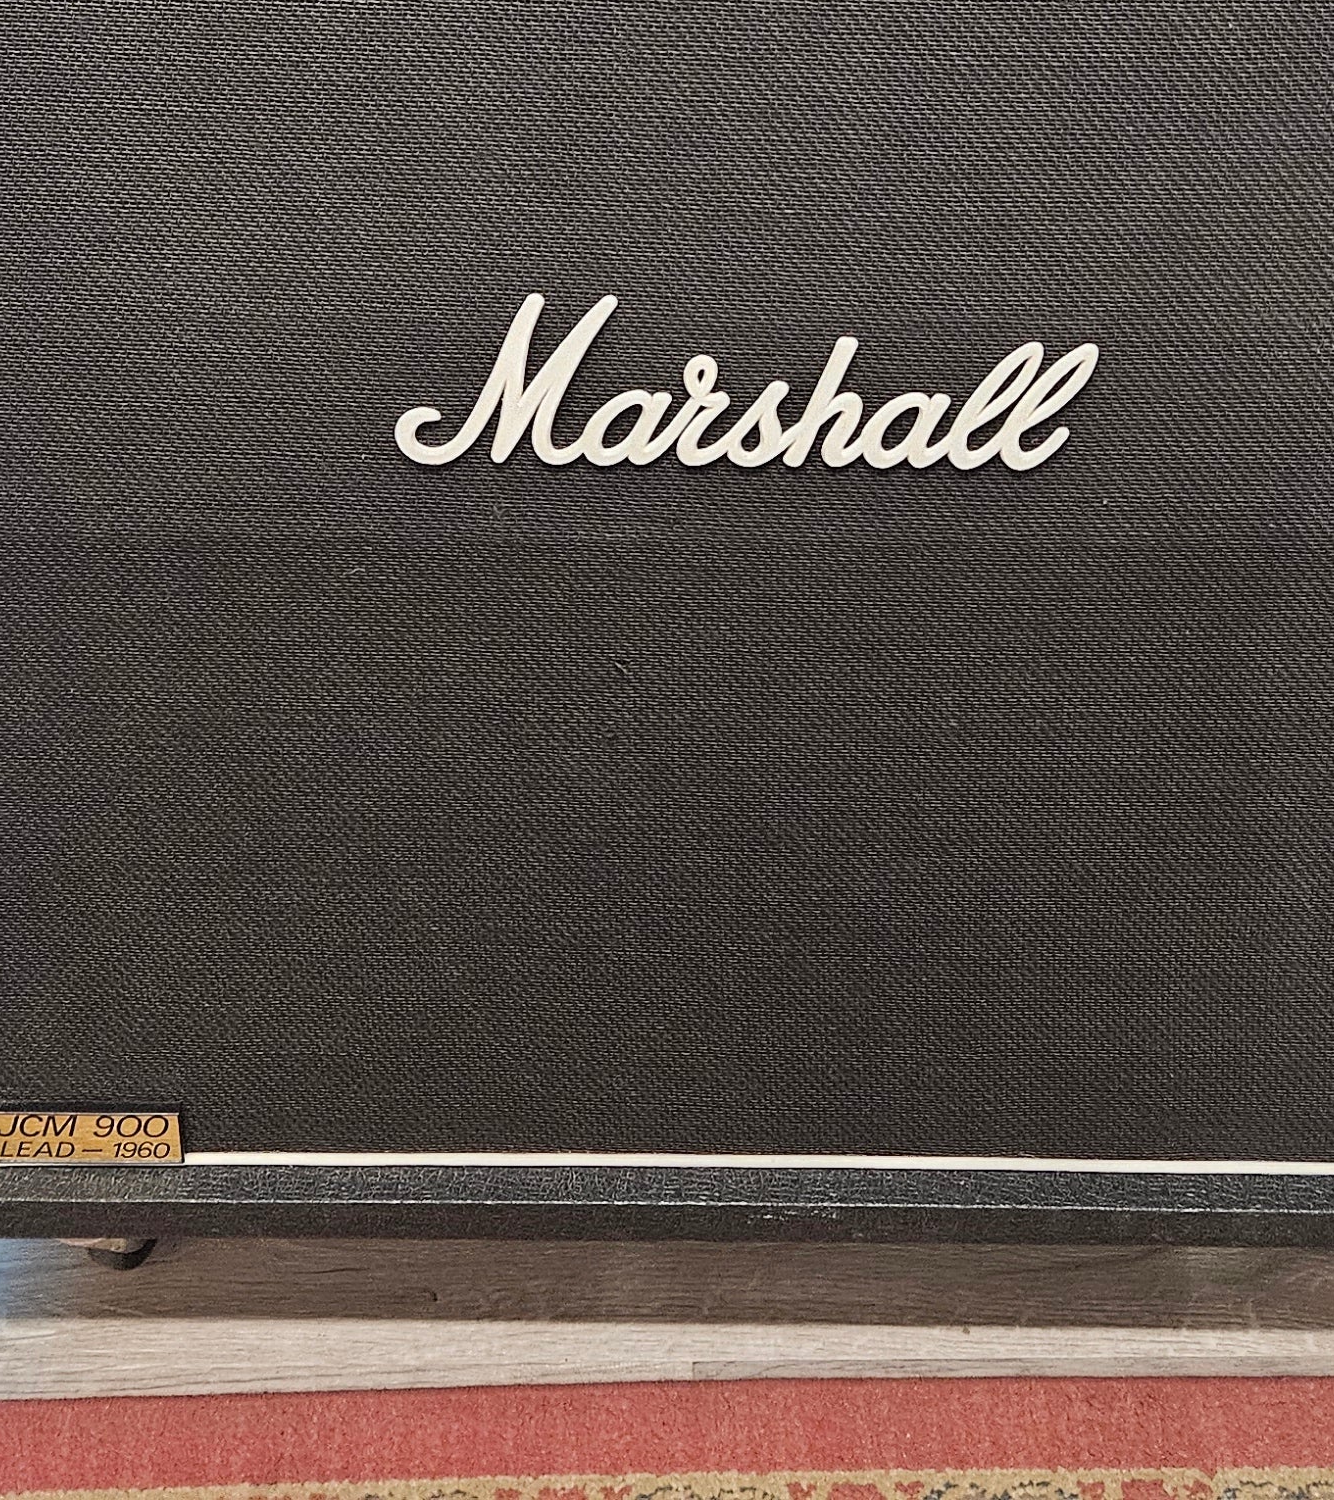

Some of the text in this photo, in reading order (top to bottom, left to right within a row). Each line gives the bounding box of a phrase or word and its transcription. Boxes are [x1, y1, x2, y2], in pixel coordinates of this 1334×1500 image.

[394, 293, 1100, 471] Marshall
[92, 1114, 170, 1138] 900
[0, 1141, 171, 1159] LEAD 1960
